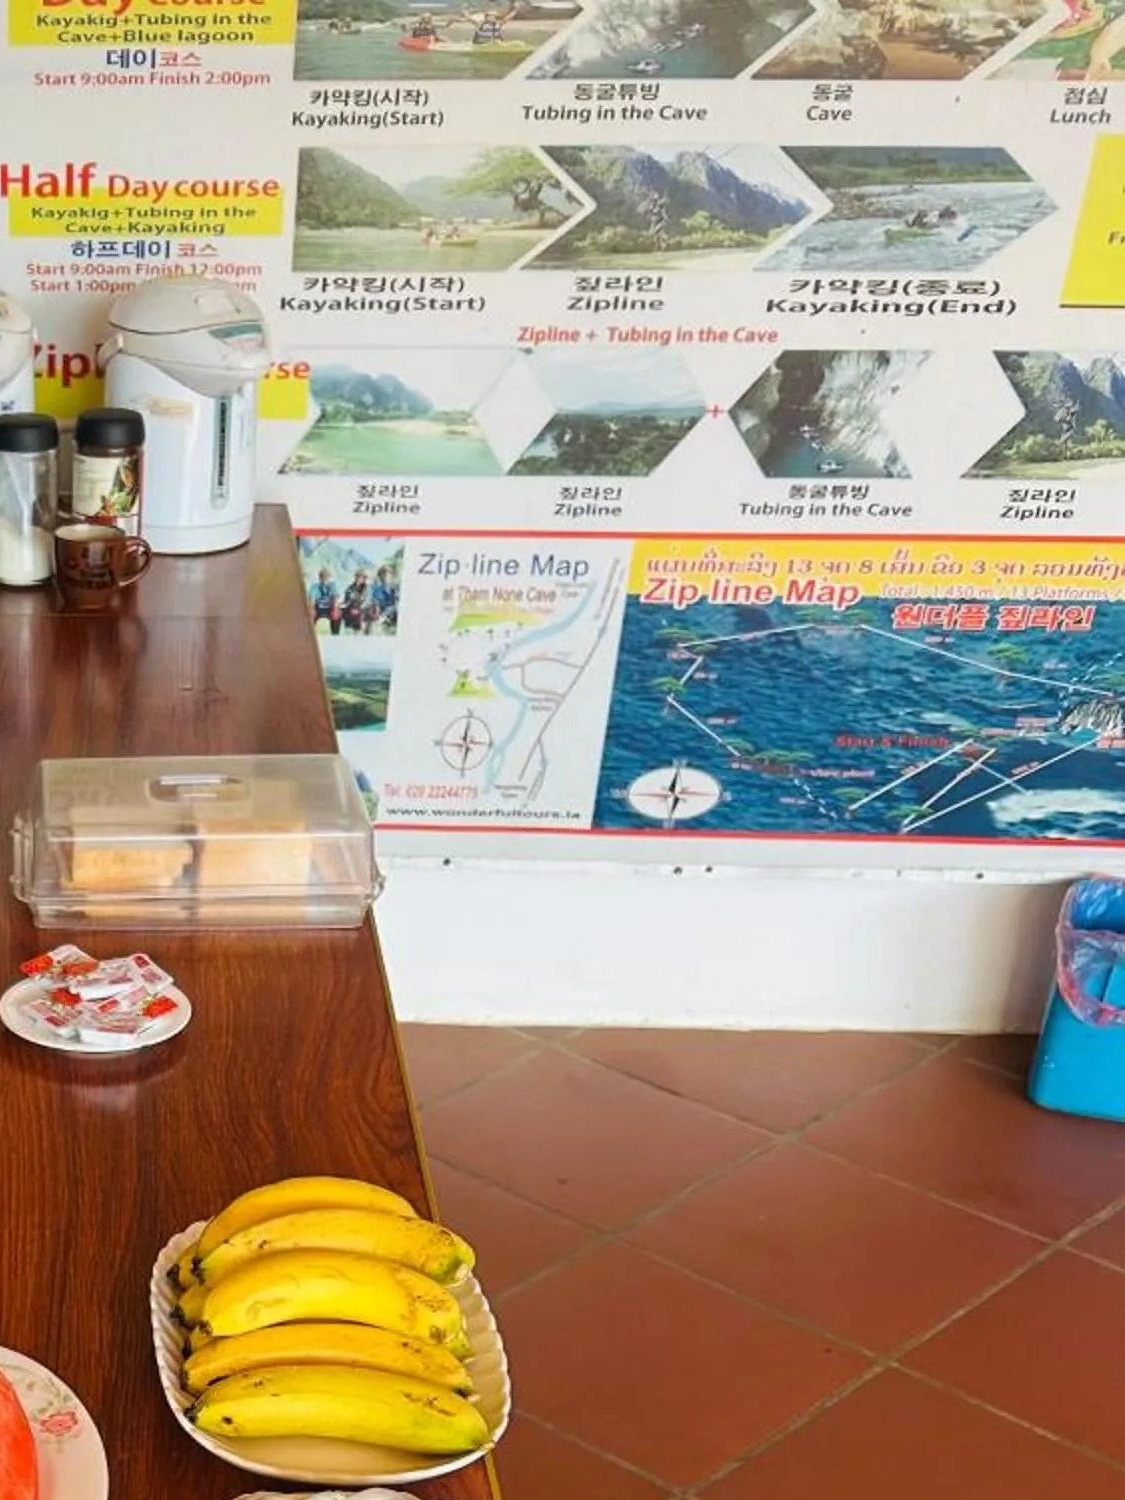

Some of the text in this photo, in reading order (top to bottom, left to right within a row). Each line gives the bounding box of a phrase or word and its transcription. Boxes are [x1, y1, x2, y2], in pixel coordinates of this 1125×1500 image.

[212, 14, 231, 25] in
[238, 13, 272, 25] the
[178, 30, 254, 44] lagoon
[34, 72, 75, 85] Start
[149, 72, 200, 85] Finish
[205, 72, 271, 87] 2:00pm
[292, 111, 444, 129] Kayaking(Start)
[522, 106, 708, 123] Tubing in the Cave
[806, 106, 852, 121] Cave
[1050, 109, 1112, 125] Lunch
[0, 163, 280, 203] Half Day course
[201, 207, 218, 218] in
[224, 207, 257, 218] the
[27, 264, 65, 275] Start
[136, 263, 185, 275] Finish
[31, 280, 70, 292] Start
[280, 296, 486, 313] Kayaking(Start)
[567, 297, 665, 313] Zipline
[766, 299, 1017, 316] Kayaking(End)
[517, 326, 580, 344] Zipline
[607, 326, 672, 346] Tubing
[676, 327, 693, 343] in
[698, 327, 729, 343] the
[733, 327, 778, 343] Cave
[353, 501, 421, 517] Zipline
[554, 503, 623, 518] Zipline
[739, 502, 913, 518] Tubing in the Cave
[1000, 506, 1074, 521] Zipline
[530, 553, 590, 580] Map
[787, 559, 813, 574] 13
[970, 559, 987, 575] 3
[526, 586, 556, 602] Cave
[642, 577, 700, 608] Zip
[710, 578, 774, 602] line
[785, 579, 860, 608] Map
